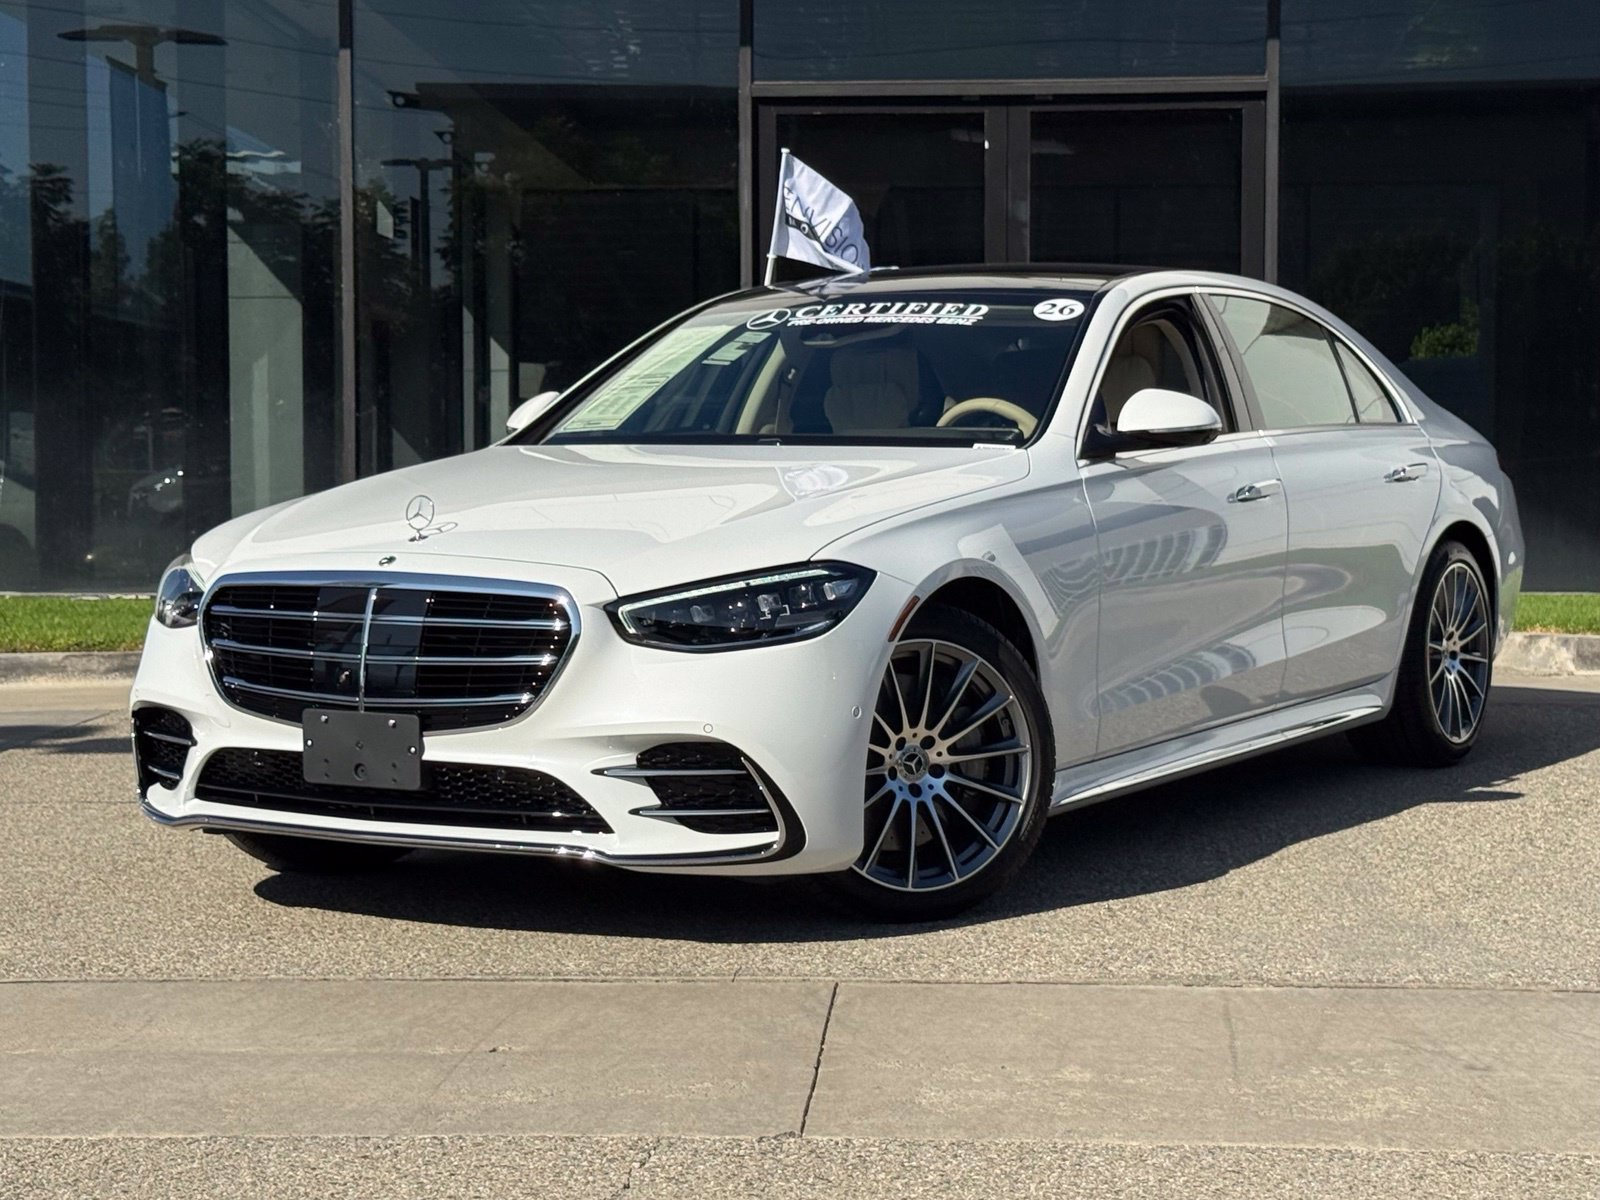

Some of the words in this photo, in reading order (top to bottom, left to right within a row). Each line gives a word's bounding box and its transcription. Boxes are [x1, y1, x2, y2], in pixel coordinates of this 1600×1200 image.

[784, 186, 865, 269] ENVISIO
[795, 302, 989, 318] CERTIFIED
[1038, 302, 1078, 315] 26
[787, 317, 864, 327] PRE-OWNED
[864, 316, 937, 324] MERCEDES
[935, 317, 978, 326] BENZ
